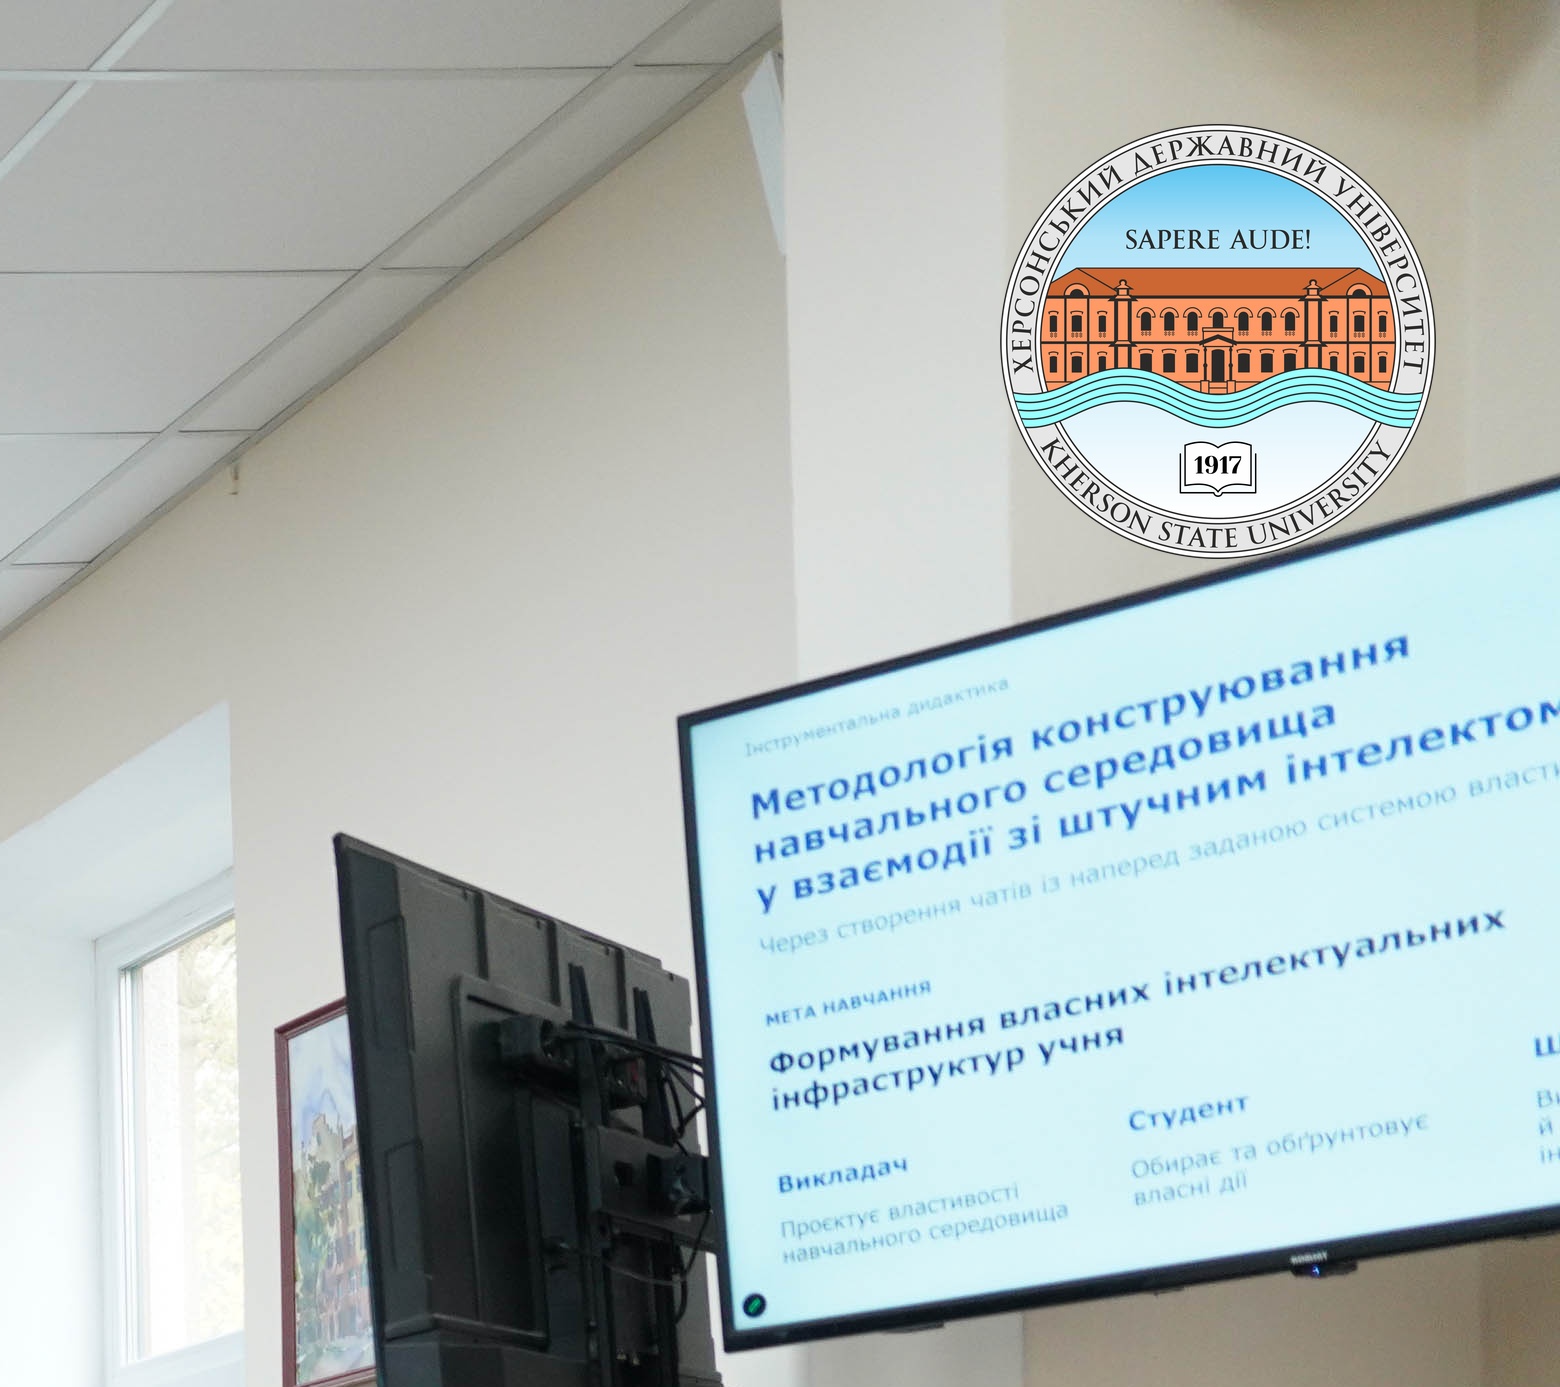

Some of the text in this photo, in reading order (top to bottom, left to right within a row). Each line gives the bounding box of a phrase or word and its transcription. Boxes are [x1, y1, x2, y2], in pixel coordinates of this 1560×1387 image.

[751, 634, 1410, 819] Методологія конструювання
[754, 701, 1336, 863] навчального середовища
[757, 884, 777, 913] у
[792, 825, 993, 900] взаємодії
[1007, 815, 1041, 851] зі
[1059, 769, 1267, 838] штучним
[759, 928, 829, 954] Через
[837, 897, 962, 940] створення
[970, 881, 1033, 909] чатів
[1041, 874, 1062, 895] із
[1070, 849, 1181, 888] наперед
[1188, 819, 1308, 861] заданою
[1317, 784, 1457, 832] системою
[765, 980, 932, 1027] МЕТА НАВЧАННЯ
[769, 909, 1507, 1074] Формування власних інтелектуальних
[772, 1026, 1125, 1111] інфраструктур учня
[1128, 1095, 1250, 1132] Студент
[778, 1157, 909, 1193] Викладач
[1131, 1151, 1222, 1180] Обирає
[1231, 1143, 1257, 1162] та
[1133, 1170, 1248, 1207] власні дії
[781, 1181, 1020, 1240] Проєктує властивості
[782, 1201, 1070, 1265] навчального середовища
